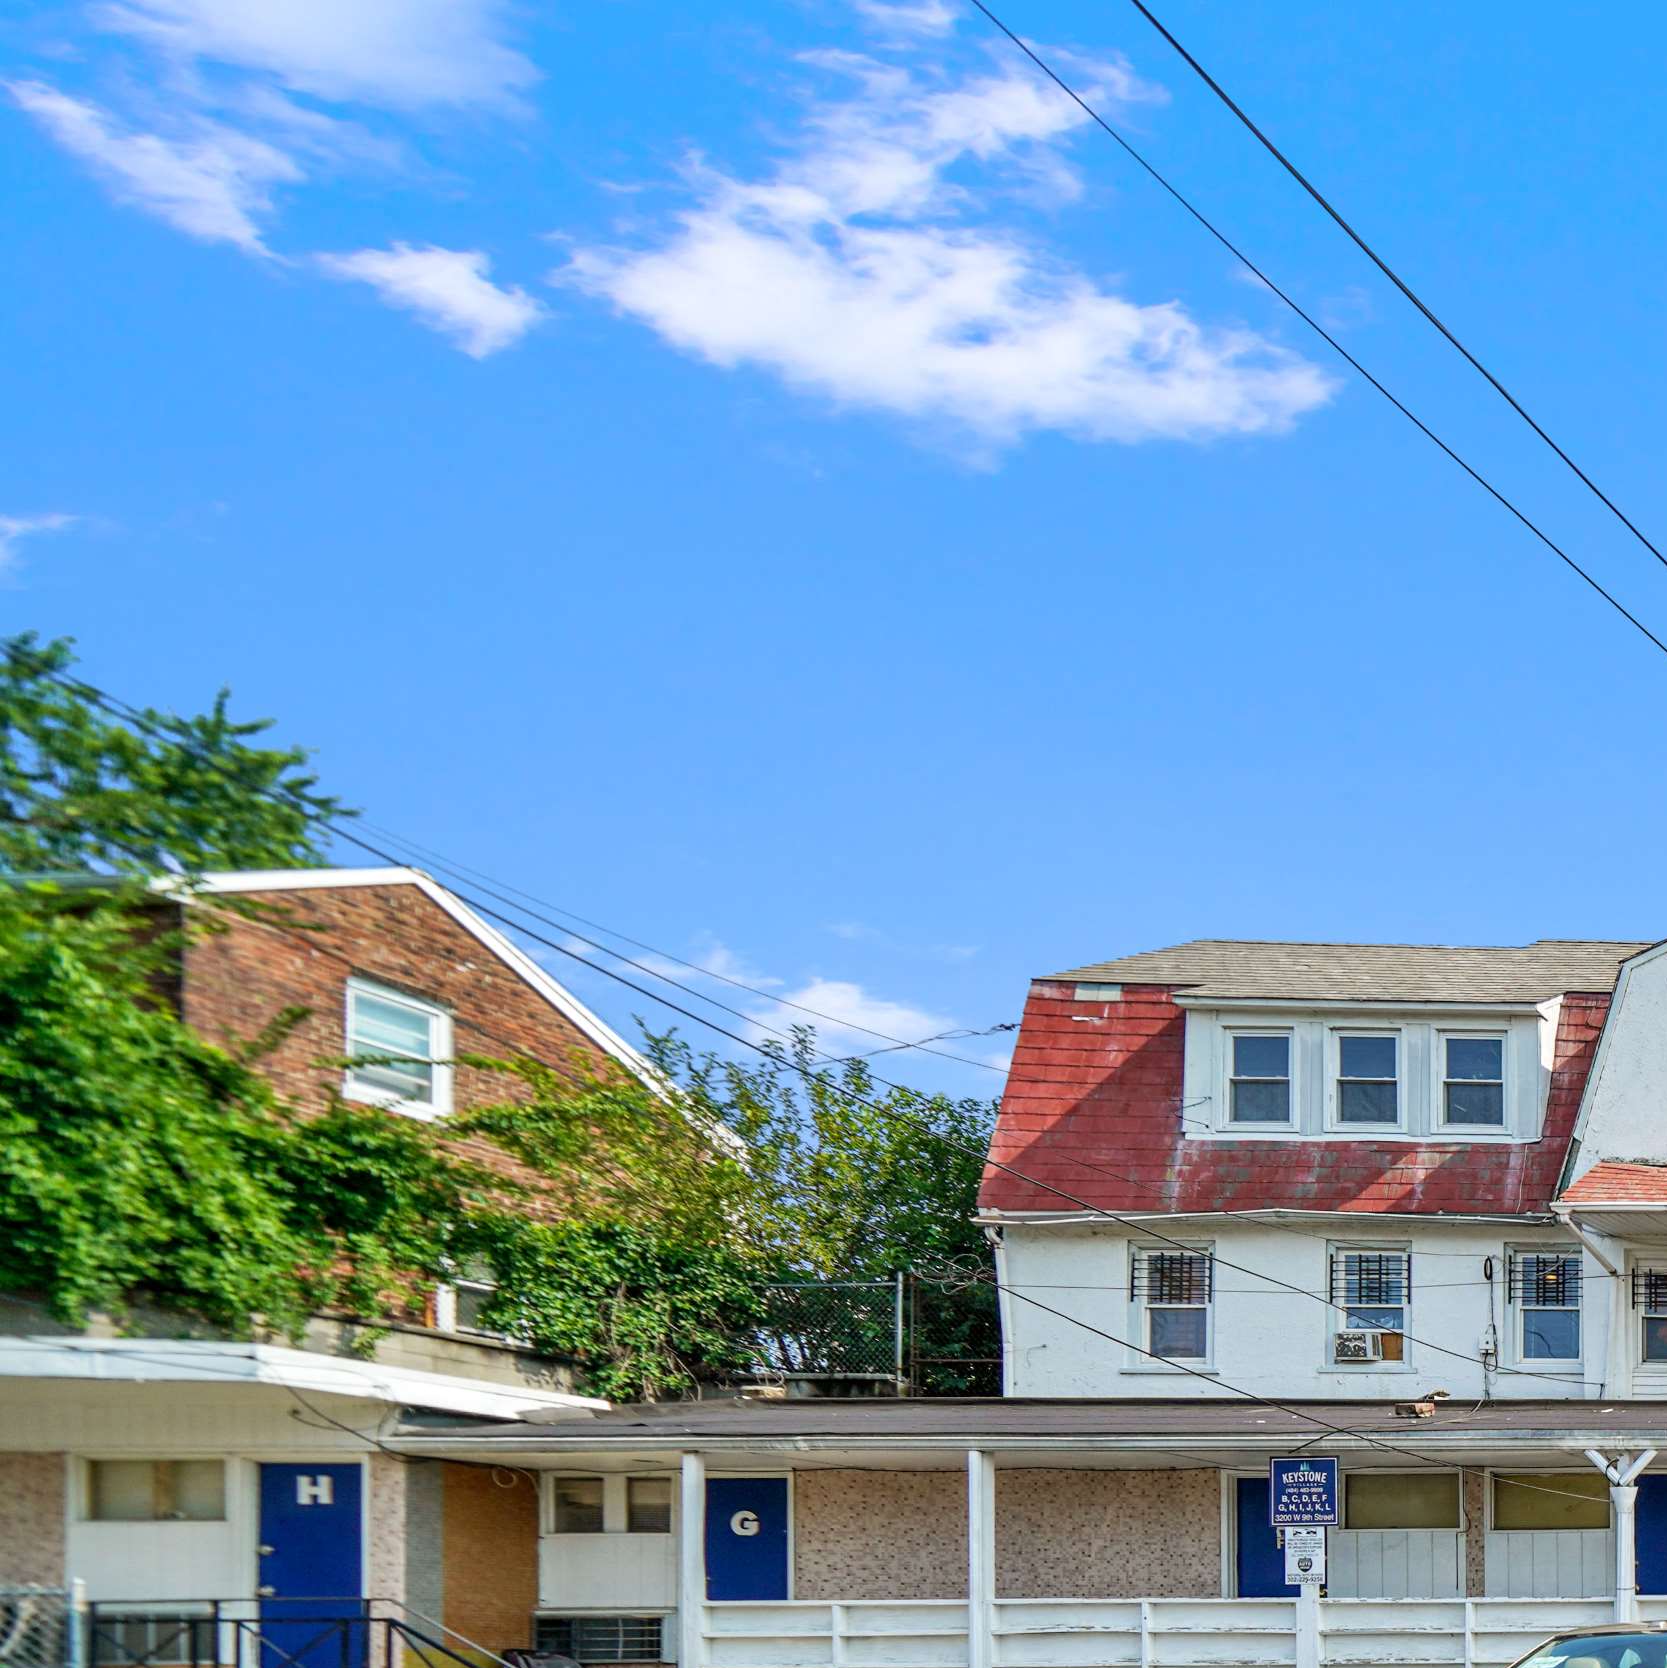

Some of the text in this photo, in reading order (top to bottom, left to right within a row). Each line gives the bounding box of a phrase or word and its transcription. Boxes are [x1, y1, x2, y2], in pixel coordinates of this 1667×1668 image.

[1282, 1471, 1327, 1484] KEYSTONE
[296, 1475, 333, 1505] H
[1281, 1494, 1328, 1504] B, C, D, E, F
[1278, 1503, 1288, 1512] G,
[1288, 1503, 1298, 1512] H,
[1306, 1503, 1314, 1512] J,
[1315, 1503, 1324, 1512] K,
[1325, 1502, 1332, 1511] L
[729, 1509, 761, 1537] G
[1274, 1514, 1292, 1522] 3200
[1301, 1513, 1313, 1521] 9th
[1314, 1513, 1335, 1521] Street
